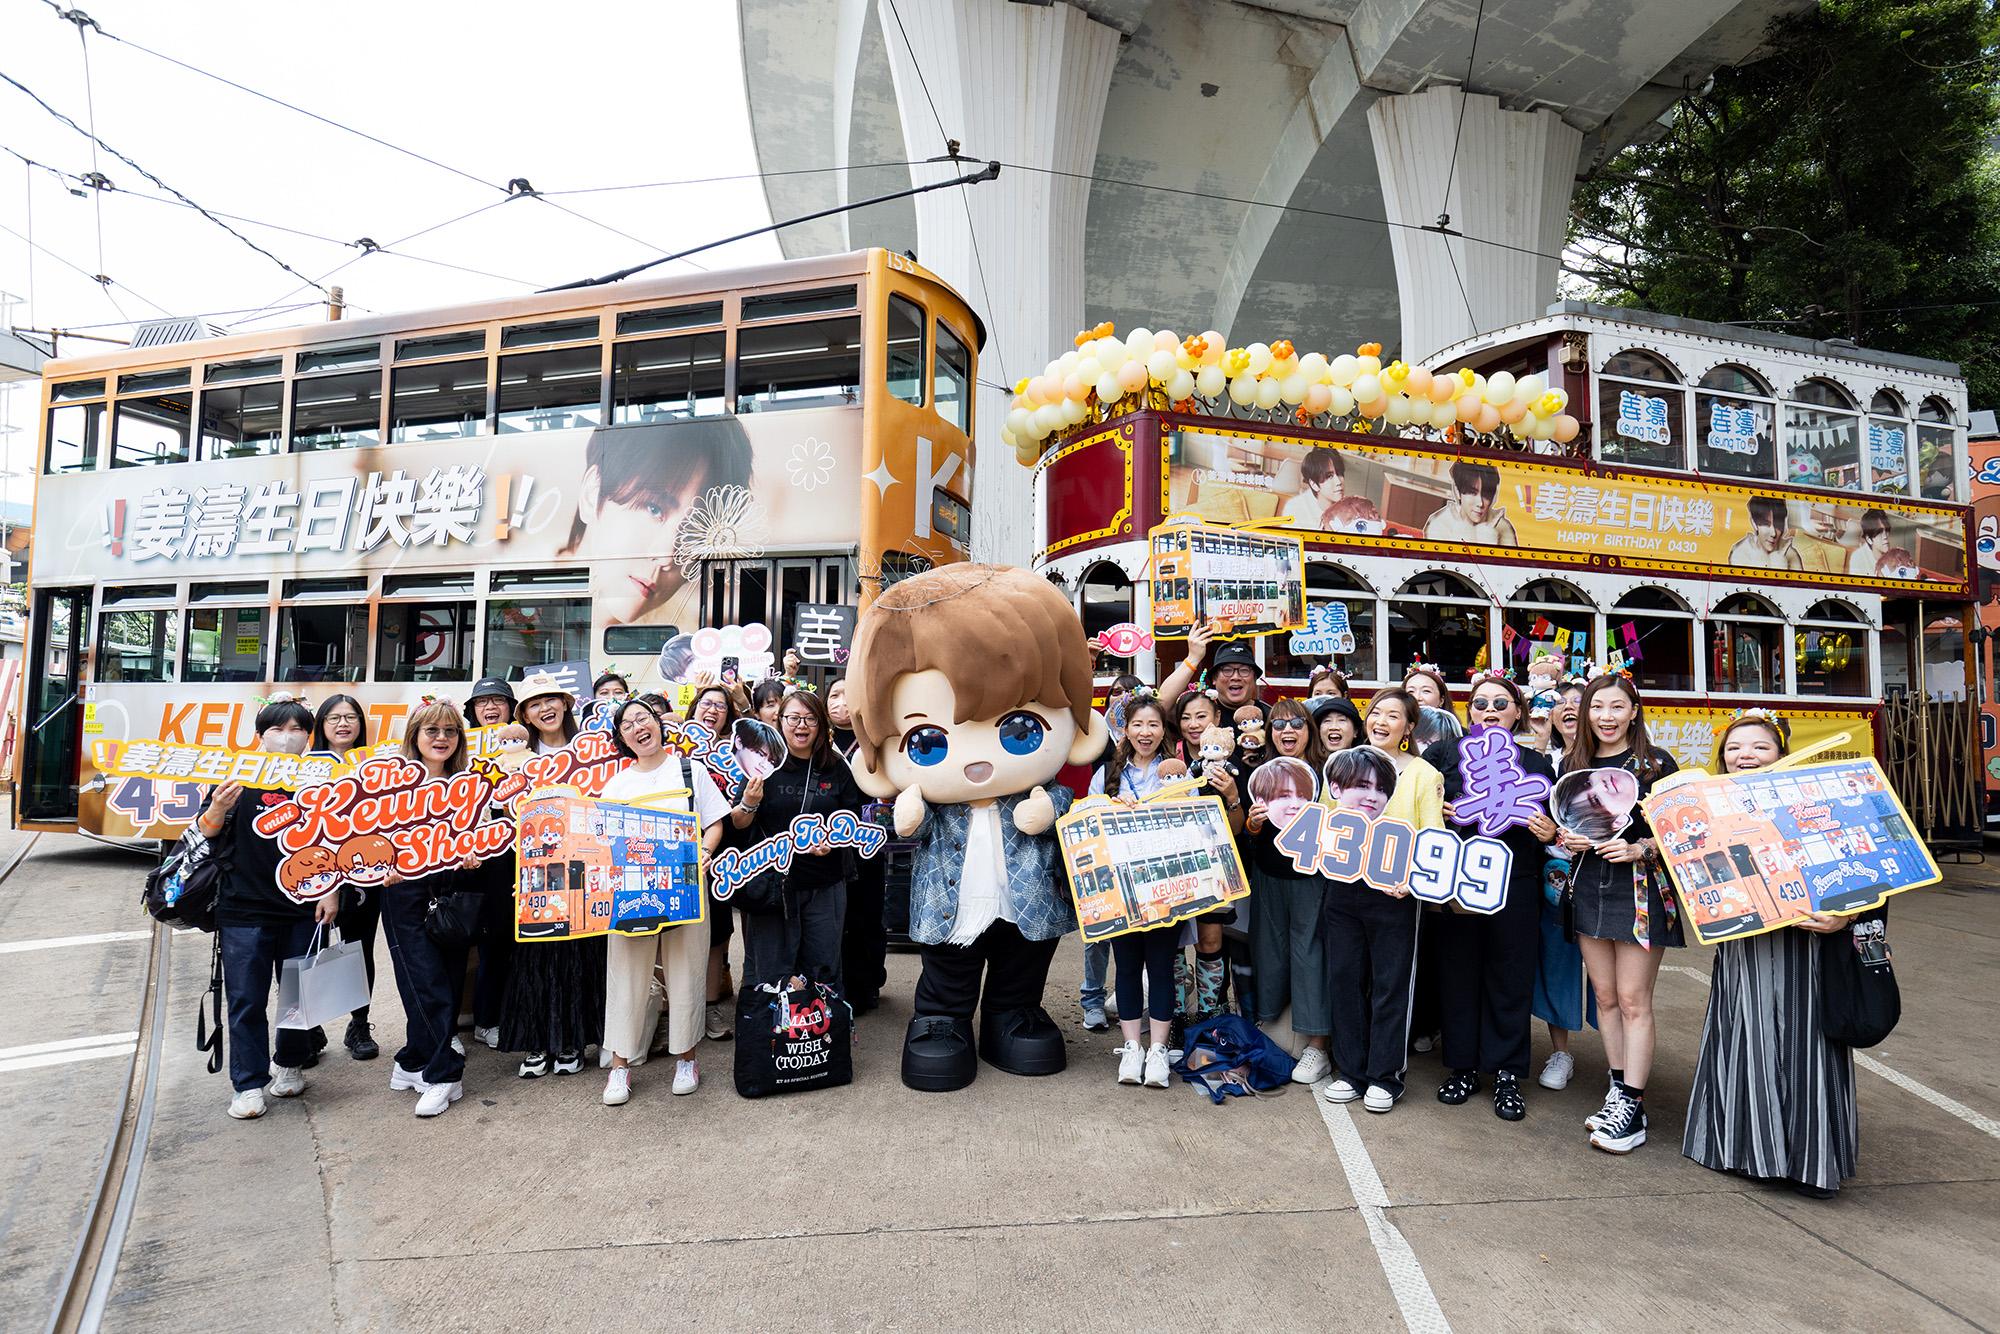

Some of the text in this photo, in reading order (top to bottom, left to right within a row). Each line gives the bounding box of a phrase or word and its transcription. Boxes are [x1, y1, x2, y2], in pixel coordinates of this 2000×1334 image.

[888, 251, 915, 274] 153
[1557, 530, 1698, 554] HAPPY BIRTHDAY 0430
[1220, 602, 1264, 616] KEUNG TO
[1291, 637, 1324, 655] Keung
[361, 760, 420, 792] The
[1455, 731, 1547, 832] 姜
[497, 776, 524, 799] mini
[264, 772, 486, 849] mini Keung
[391, 821, 512, 871] Show
[715, 815, 883, 895] Keung To Day
[1151, 875, 1199, 899] KEUNG TO
[1778, 880, 1806, 903] 430
[1815, 868, 1843, 897] Keung
[1854, 861, 1880, 882] Day
[1879, 857, 1900, 875] 99
[528, 895, 547, 909] 430
[591, 901, 610, 918] 430
[669, 896, 680, 911] 99
[1698, 889, 1721, 907] 430
[1741, 915, 1753, 924] 300
[789, 1010, 823, 1027] MAKE
[800, 1028, 810, 1040] A
[785, 1039, 823, 1055] WISH
[775, 1050, 831, 1070] (TO)DAY
